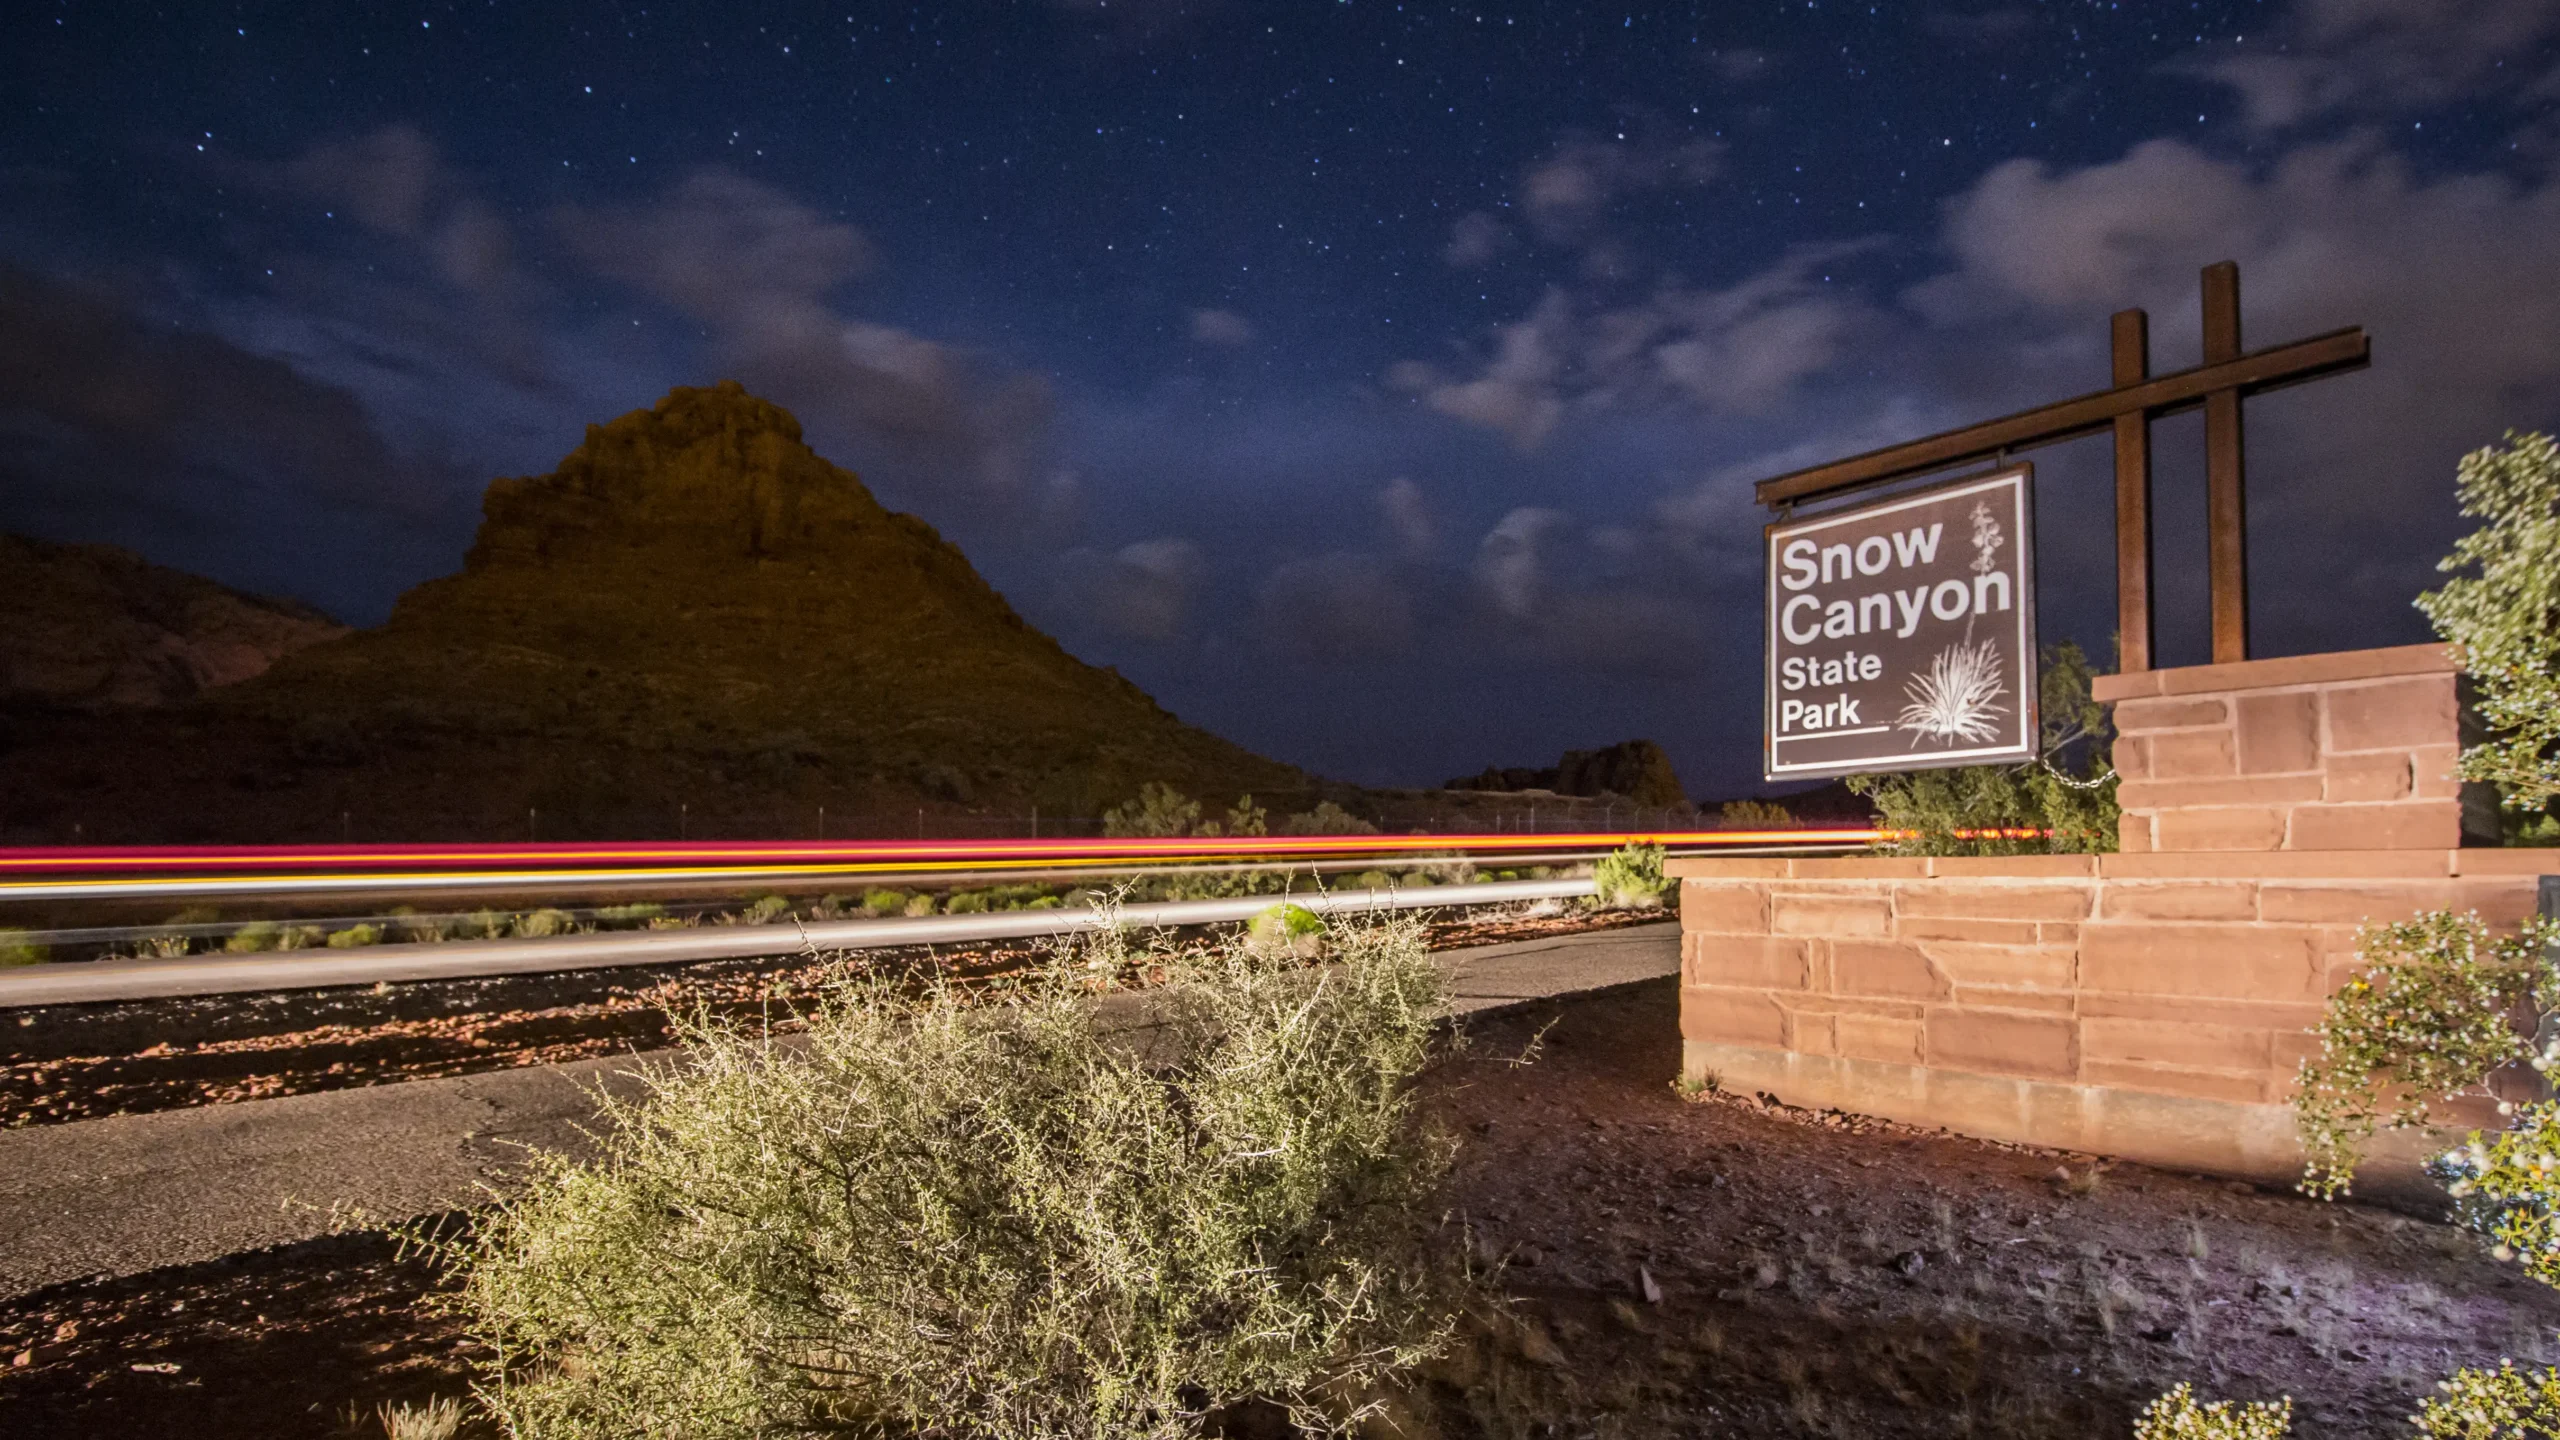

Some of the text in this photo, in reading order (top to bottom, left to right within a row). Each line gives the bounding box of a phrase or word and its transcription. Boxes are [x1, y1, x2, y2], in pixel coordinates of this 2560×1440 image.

[1781, 523, 1943, 591] Snow
[1781, 571, 2010, 645] Canyon
[1782, 651, 1882, 691] State
[1782, 693, 1861, 732] Park
